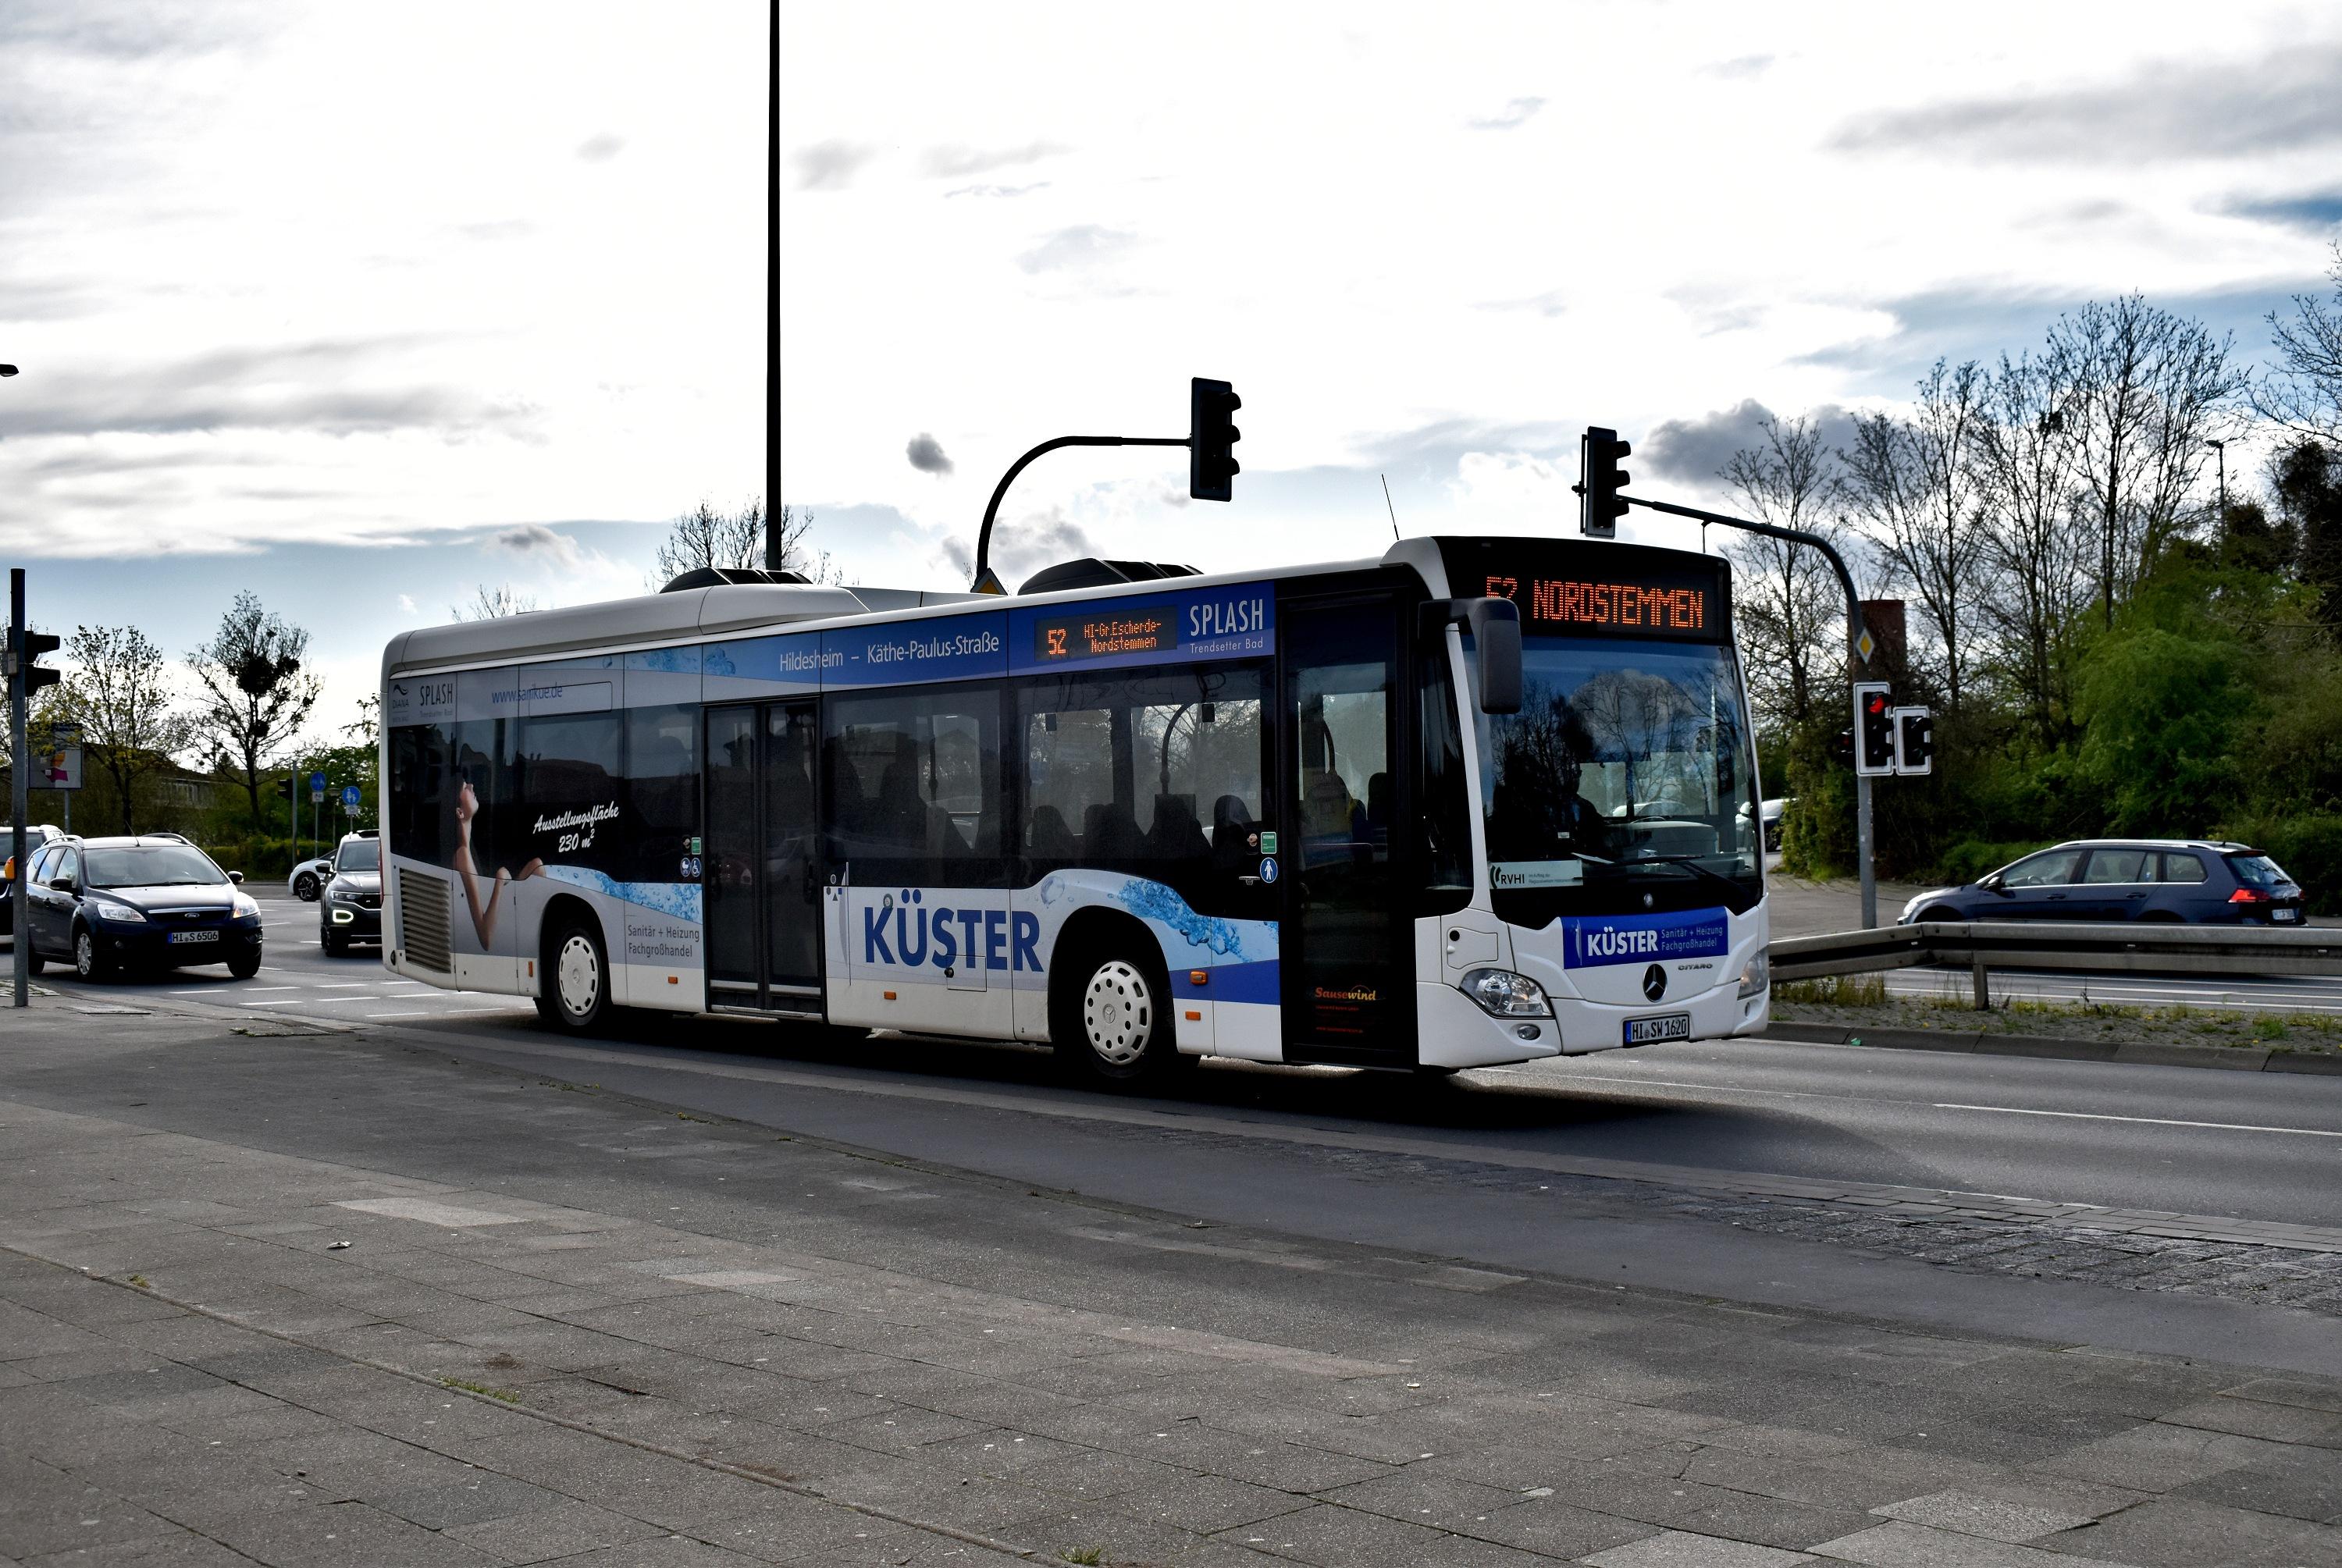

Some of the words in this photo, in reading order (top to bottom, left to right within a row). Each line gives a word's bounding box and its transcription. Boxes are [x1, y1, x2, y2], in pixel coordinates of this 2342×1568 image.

[1533, 579, 1703, 628] NORDSTEMMEN
[1190, 599, 1263, 637] SPLASH
[780, 648, 843, 672] Hildesheim
[867, 631, 1000, 663] Käthe-Paulus-Straße
[1048, 628, 1066, 655] 52
[1091, 636, 1157, 652] Nordstemmen
[1190, 641, 1242, 654] Trendsetter
[1245, 636, 1263, 649] Bad
[420, 683, 453, 706] SPLASH
[532, 800, 620, 834] Ausstellungsfläche
[558, 833, 579, 853] 230
[1500, 873, 1525, 884] RVHI
[173, 933, 183, 942] HI
[190, 933, 195, 941] S
[197, 931, 218, 940] 6506
[628, 925, 655, 937] Sanitär
[667, 926, 699, 943] Heizung
[863, 888, 1044, 972] KÜSTER
[1661, 929, 1687, 938] Sanitär
[1696, 926, 1723, 937] Heizung
[628, 942, 692, 958] Fachgroßhandel
[1587, 926, 1659, 957] KÜSTER
[1661, 938, 1717, 951] Fachgroßhandel
[1315, 987, 1376, 1001] Sausewind
[1632, 1023, 1643, 1040] HI
[1664, 1019, 1687, 1036] 1620
